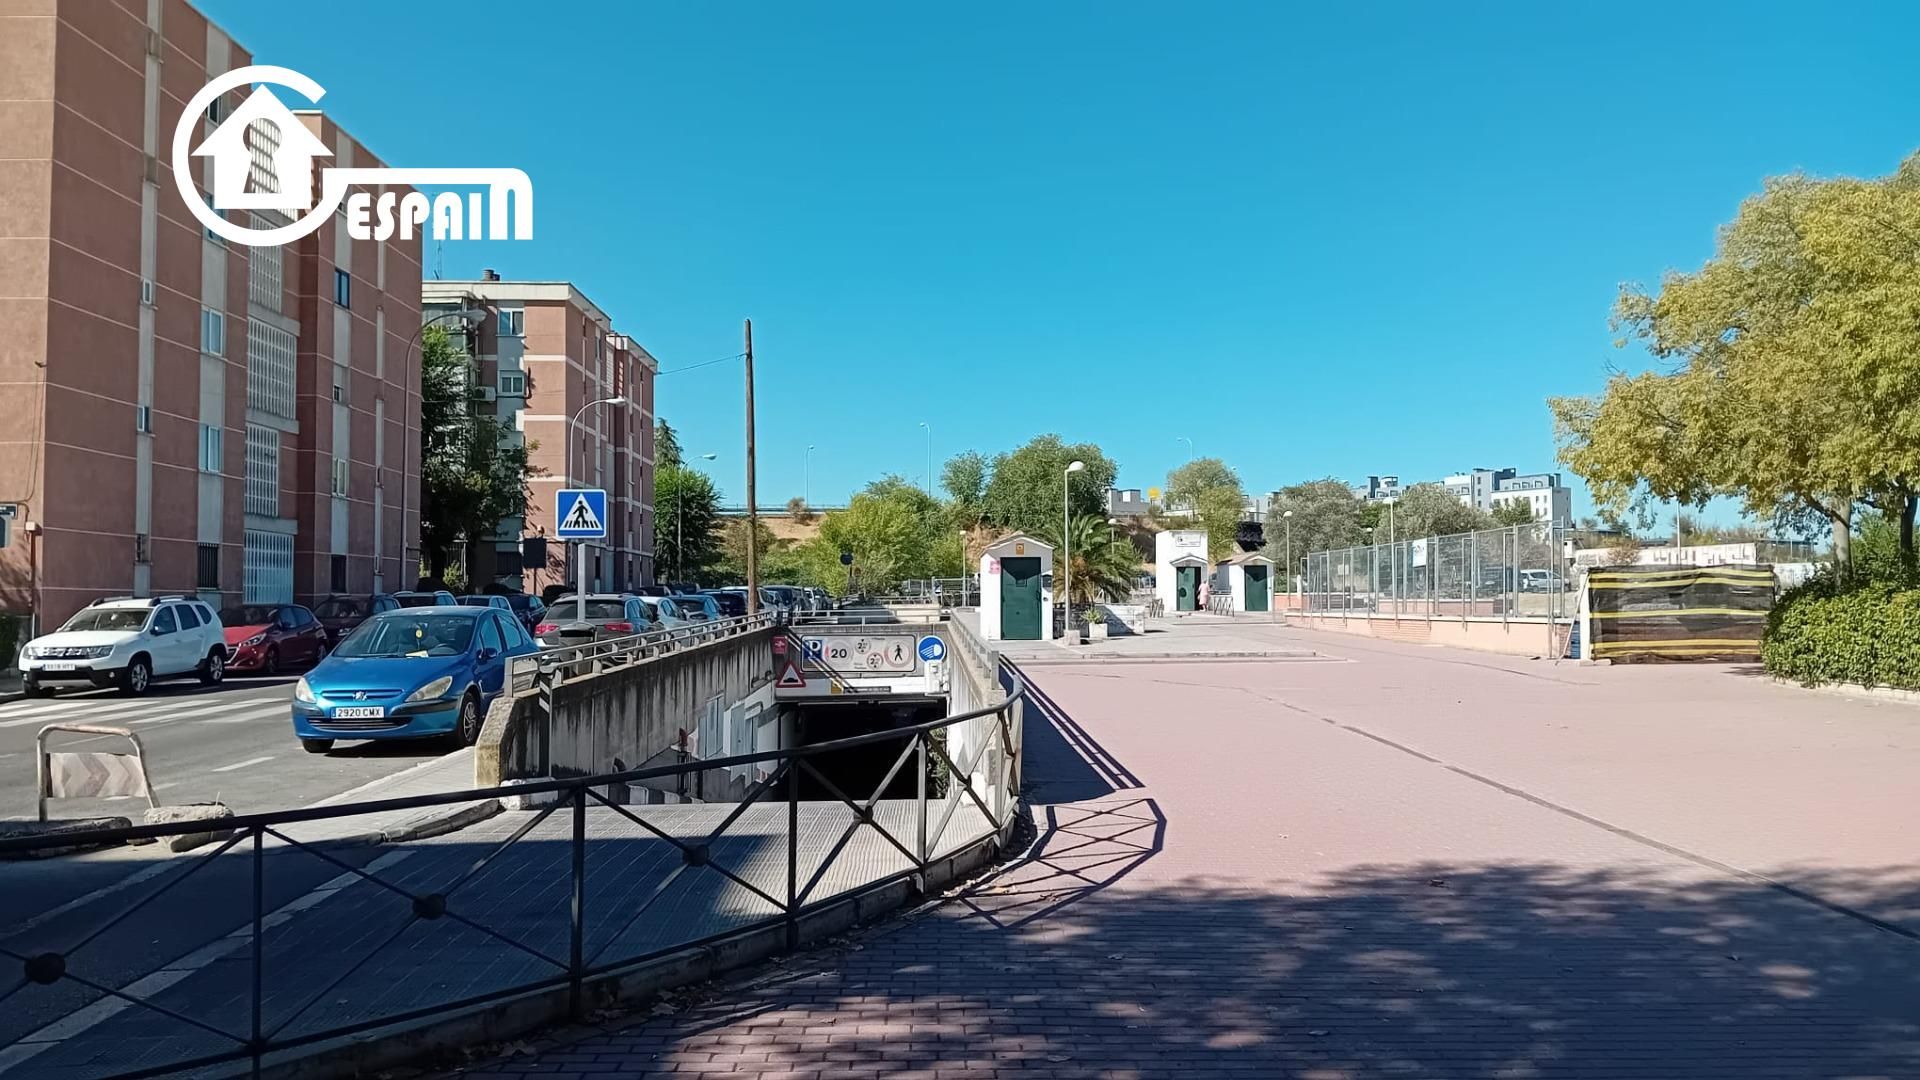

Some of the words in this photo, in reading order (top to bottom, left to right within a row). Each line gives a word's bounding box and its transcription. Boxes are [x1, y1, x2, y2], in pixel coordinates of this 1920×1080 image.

[830, 648, 848, 659] 20
[338, 708, 361, 717] 2920
[363, 707, 381, 717] CMX
